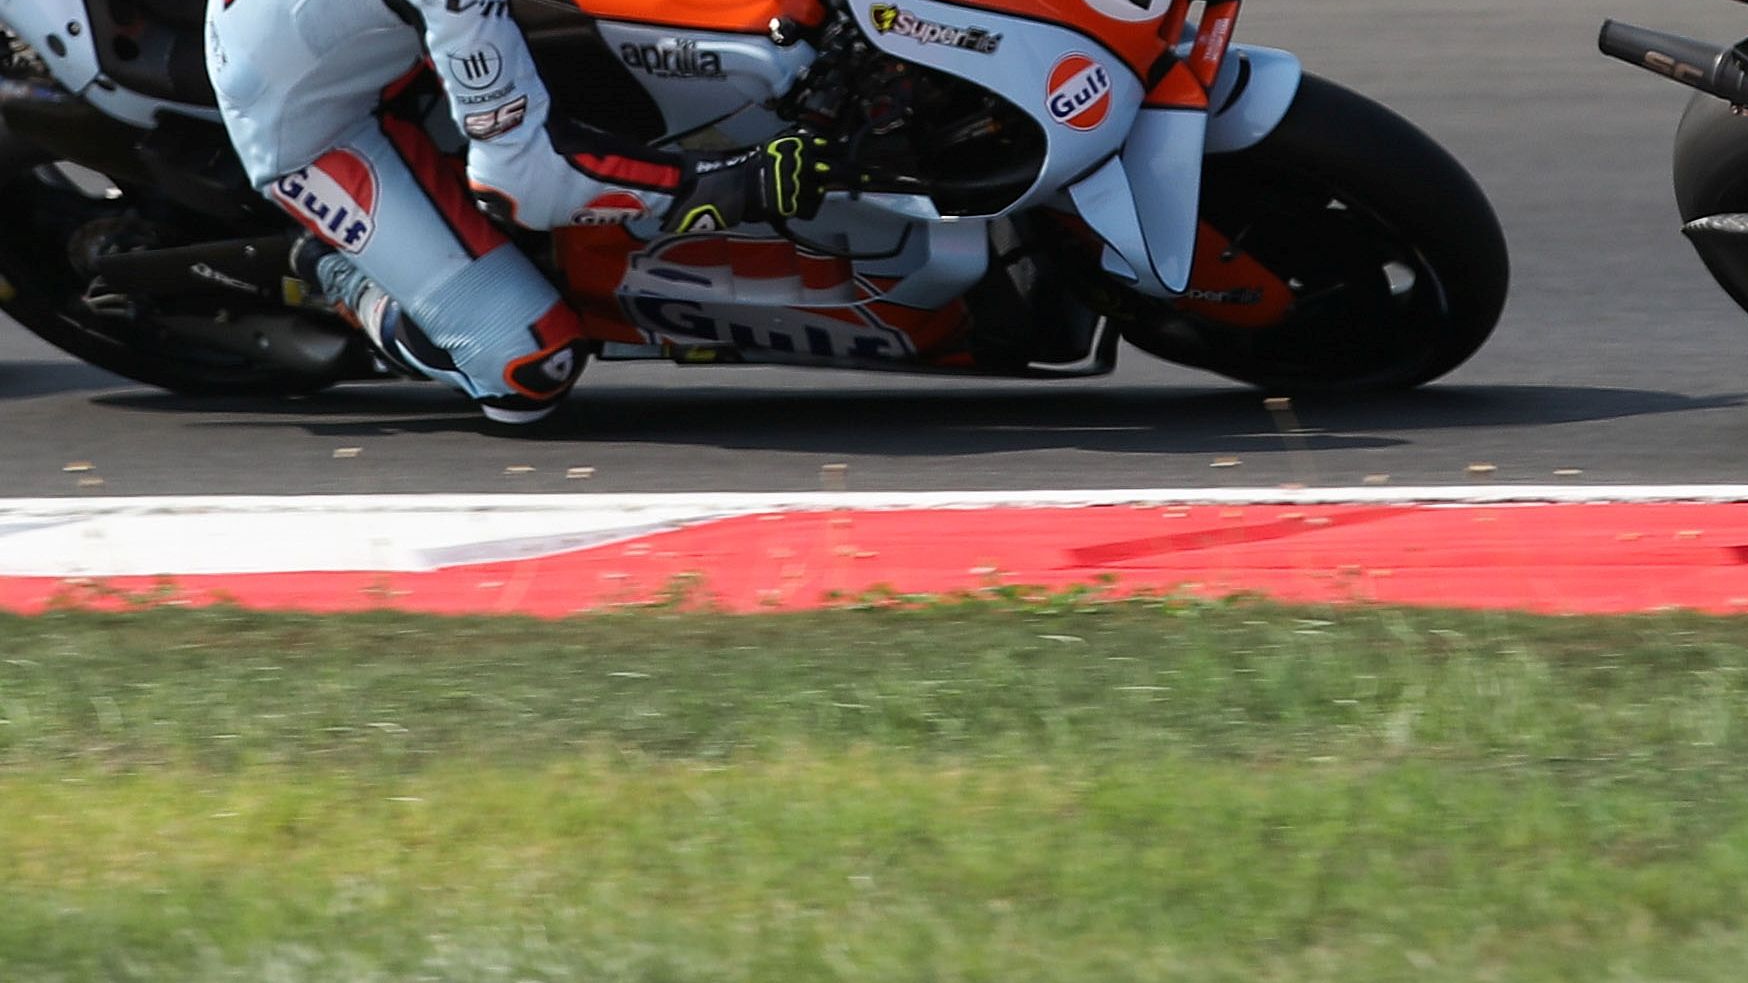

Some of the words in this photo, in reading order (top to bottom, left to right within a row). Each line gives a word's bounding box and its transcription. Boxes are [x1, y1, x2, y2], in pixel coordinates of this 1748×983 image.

[620, 37, 722, 76] aprilia
[1050, 66, 1109, 118] Gulf
[278, 167, 368, 247] Gulf
